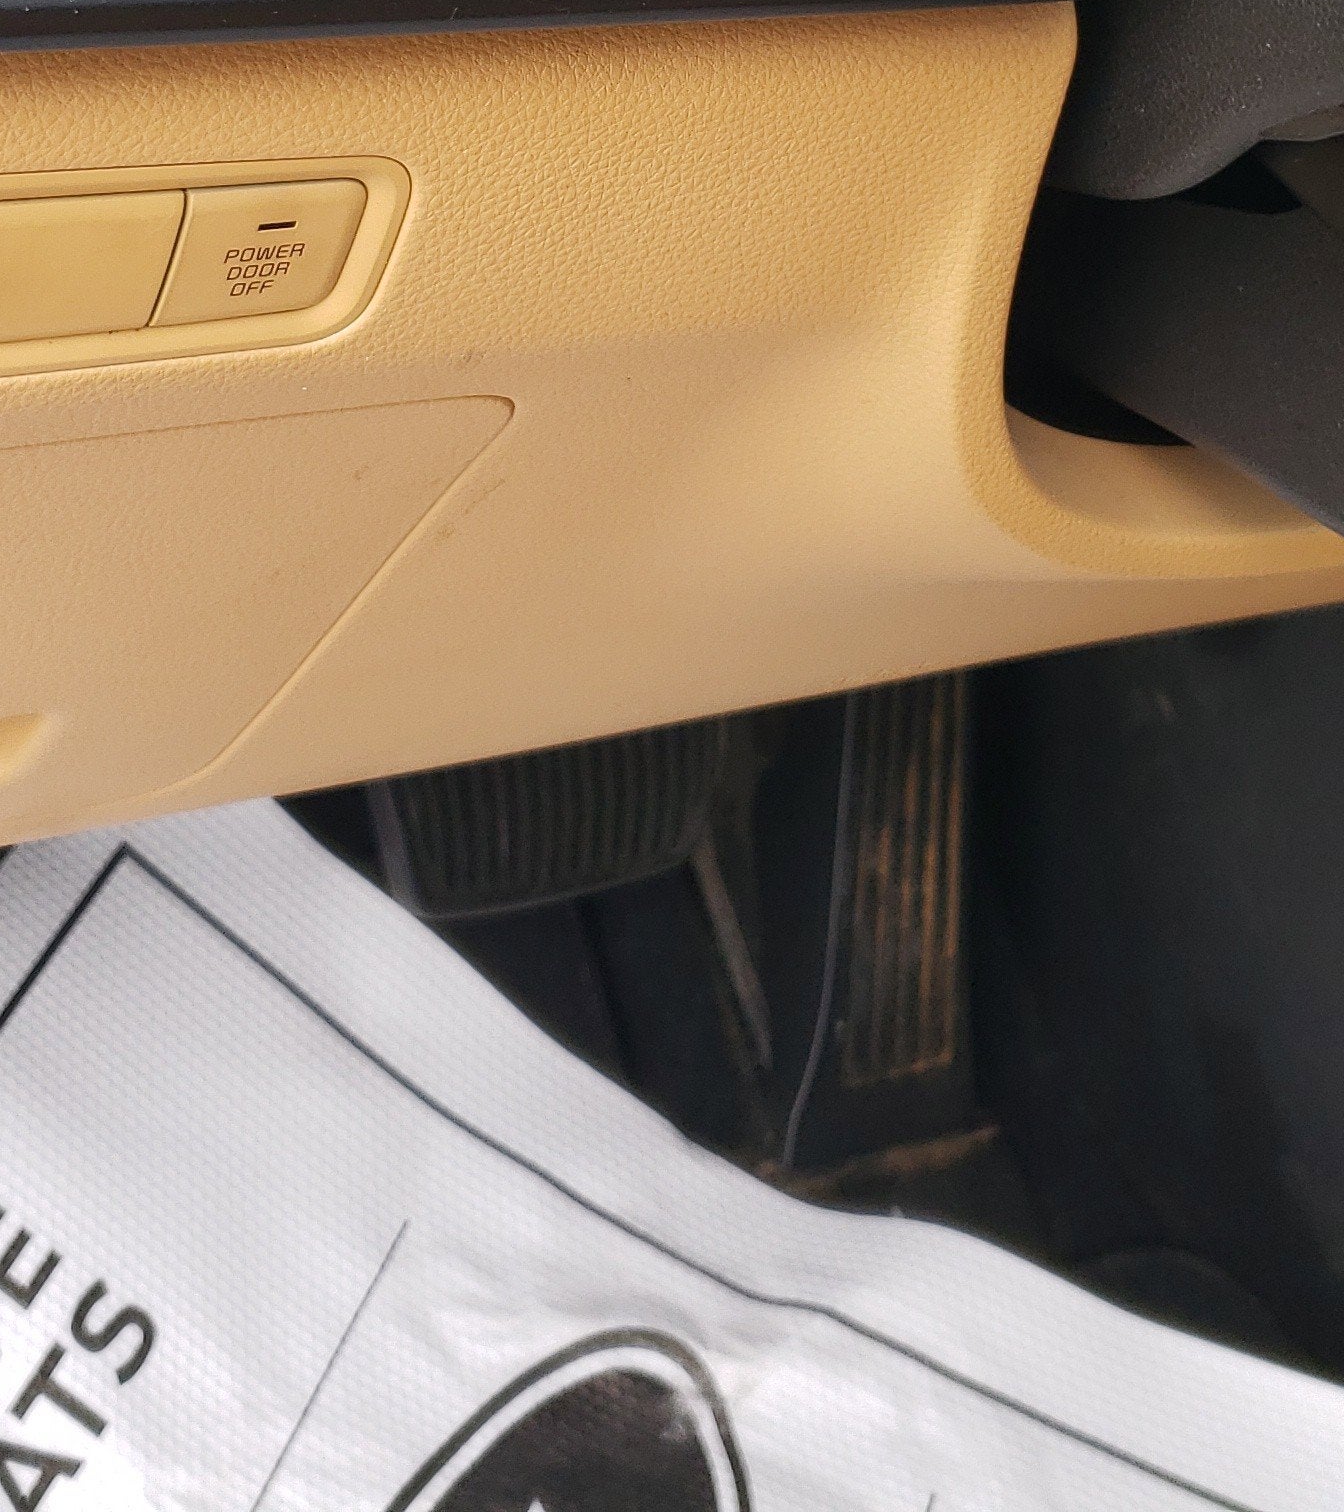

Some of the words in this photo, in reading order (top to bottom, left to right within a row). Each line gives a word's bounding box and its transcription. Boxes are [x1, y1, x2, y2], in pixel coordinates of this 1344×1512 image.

[223, 243, 305, 263] POWER
[226, 262, 290, 280] DOOR
[229, 280, 274, 296] OFF
